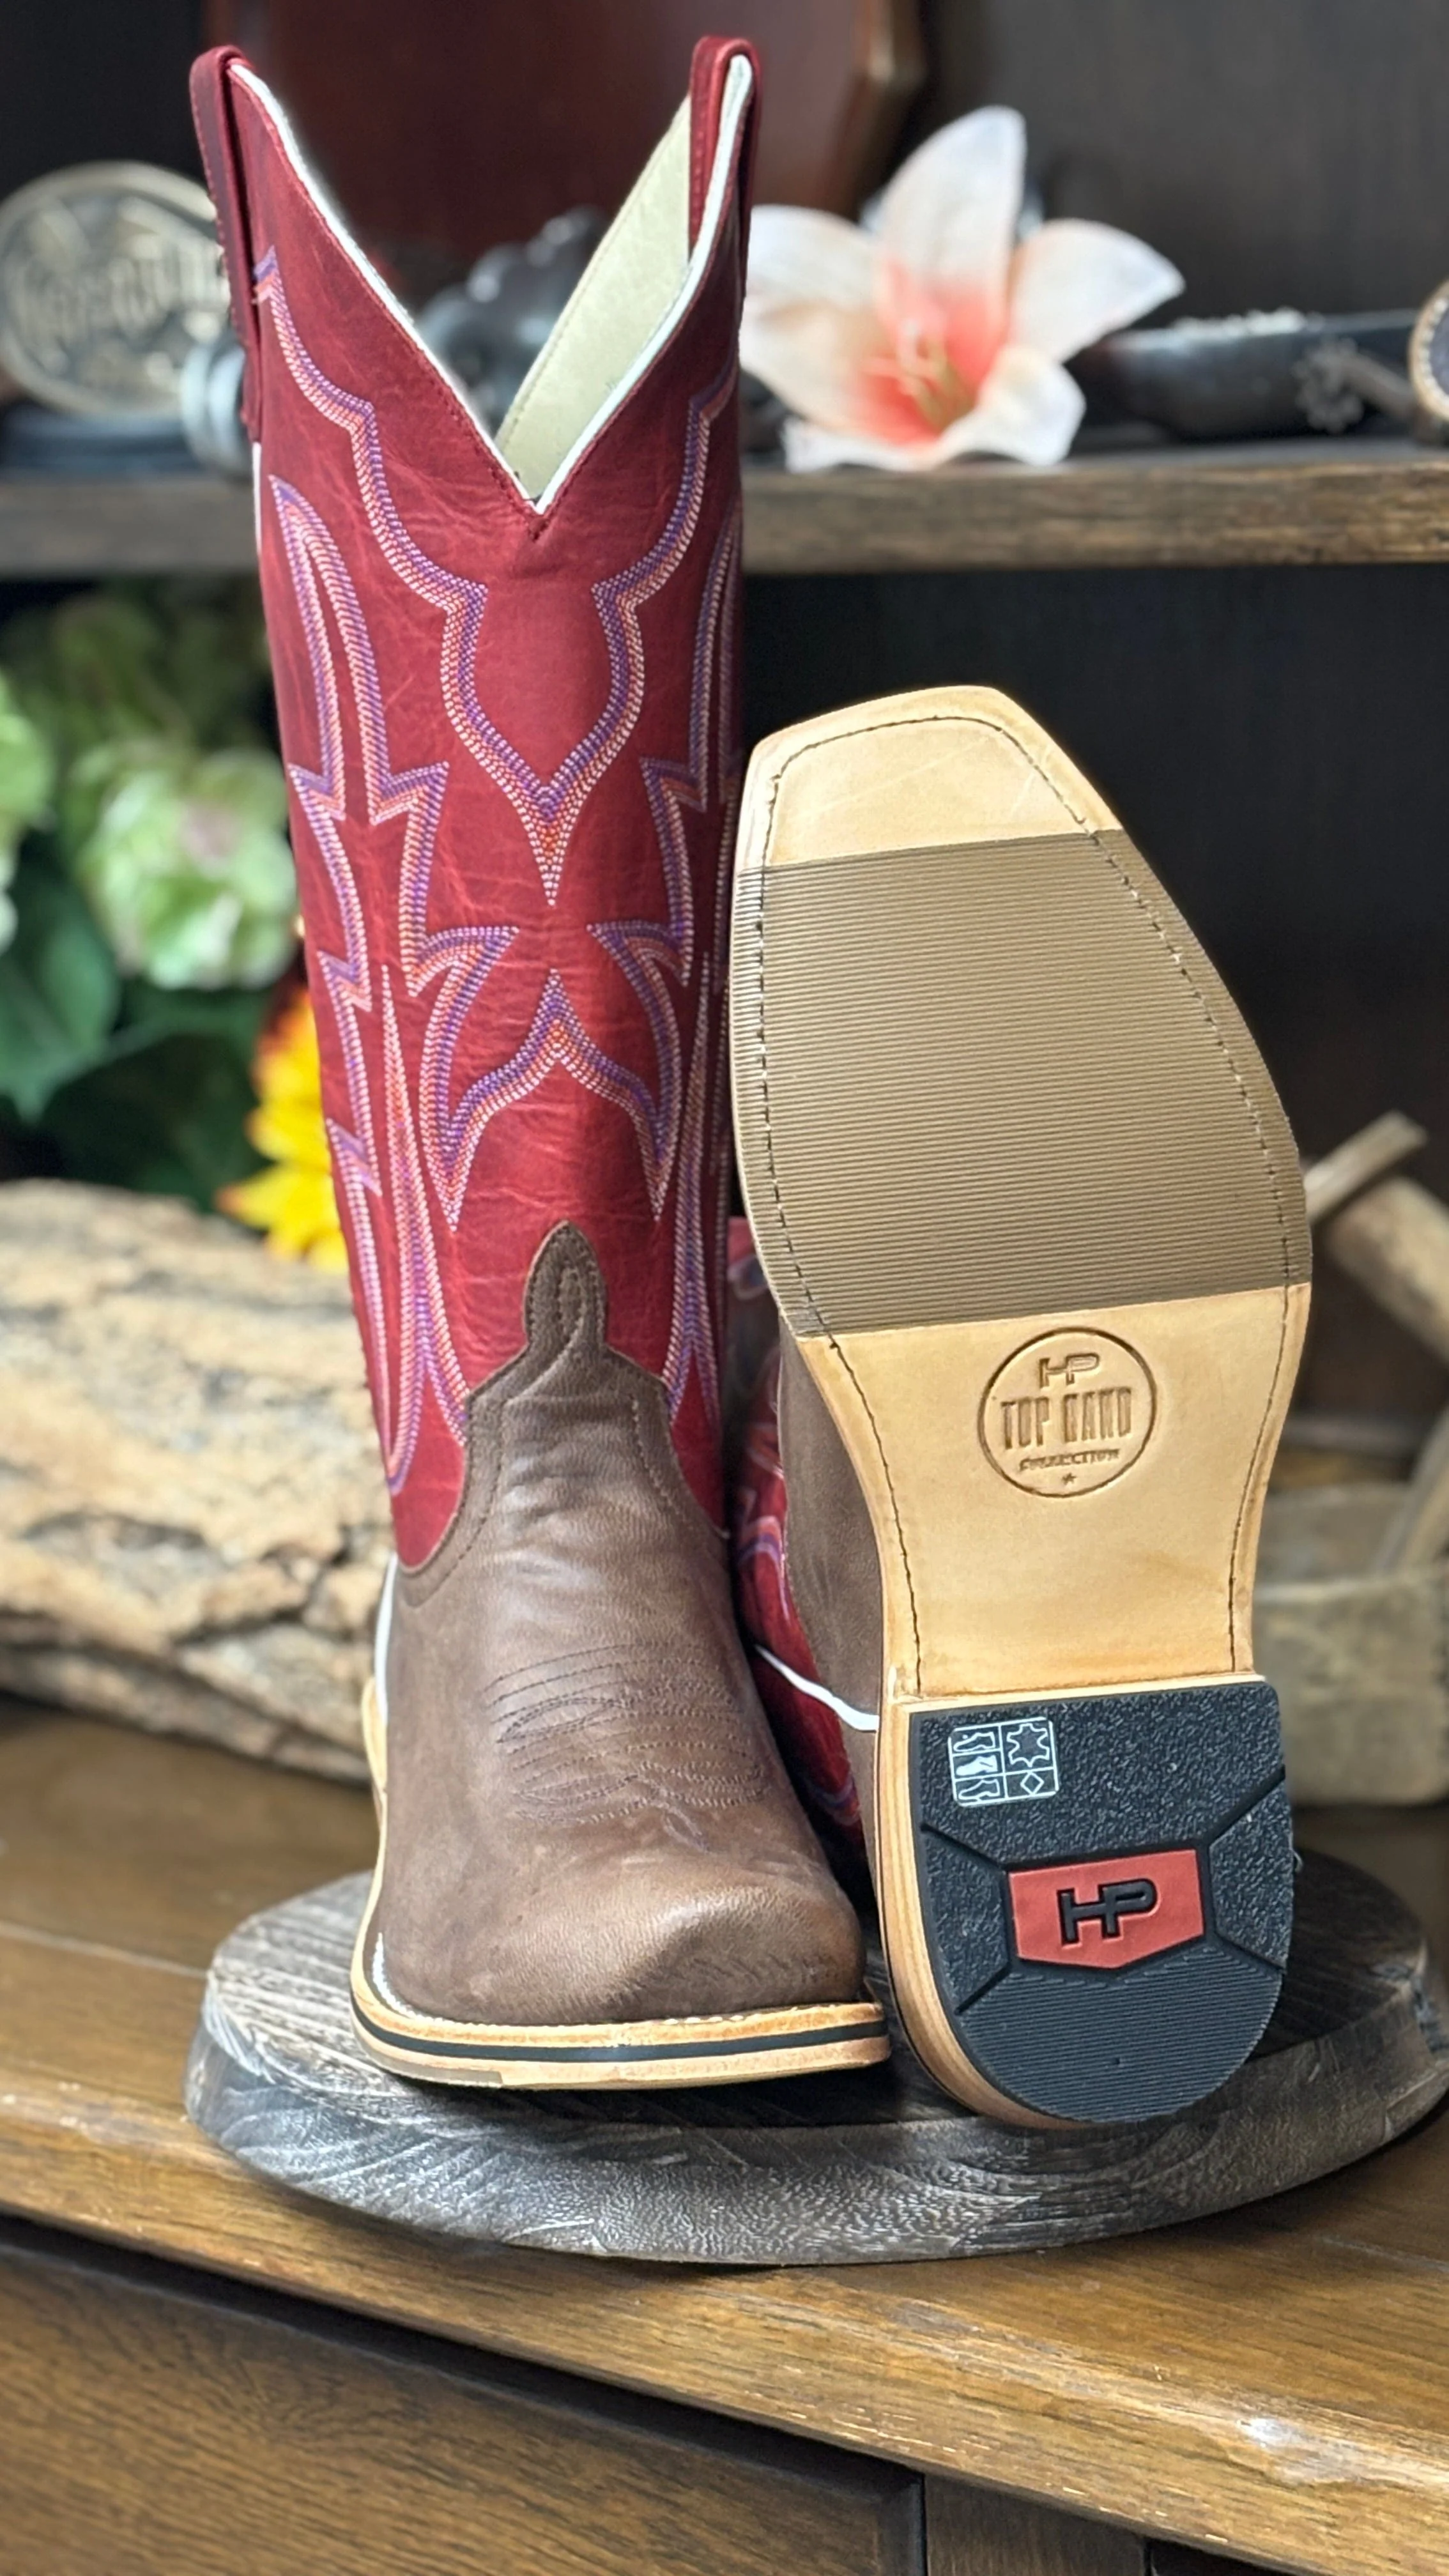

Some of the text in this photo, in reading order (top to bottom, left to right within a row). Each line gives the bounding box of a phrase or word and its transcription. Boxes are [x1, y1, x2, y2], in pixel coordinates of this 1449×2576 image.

[1039, 1353, 1100, 1389] HP
[1000, 1396, 1050, 1450] TOP
[1056, 1878, 1159, 1947] HP
